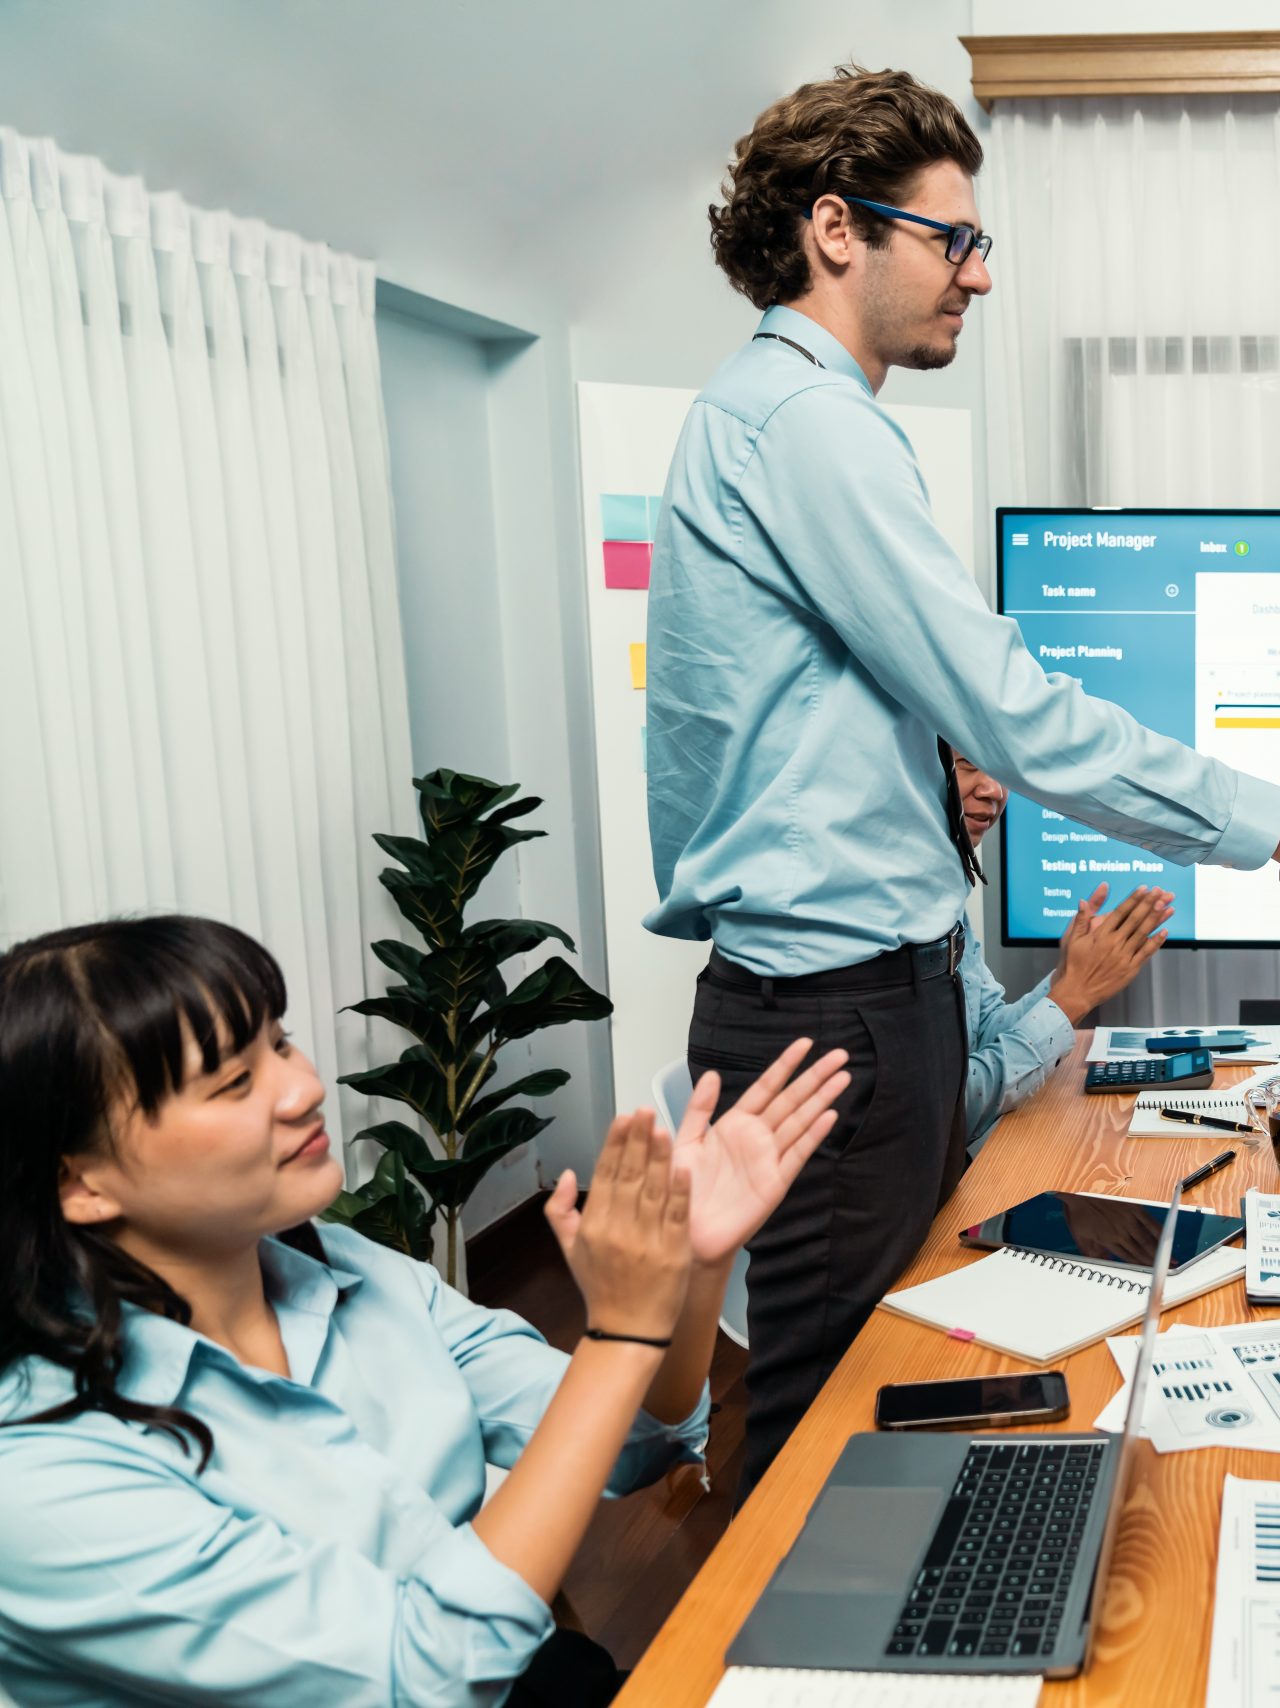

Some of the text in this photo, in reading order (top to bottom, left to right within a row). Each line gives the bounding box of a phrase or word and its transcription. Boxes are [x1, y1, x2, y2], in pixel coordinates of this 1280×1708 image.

[1043, 531, 1158, 552] Project Manager
[1199, 541, 1227, 553] Inbox
[1041, 584, 1097, 598] Task name
[1039, 644, 1123, 661] Project Planning
[1041, 808, 1066, 820] Desig
[1041, 831, 1069, 844] Design
[1041, 858, 1164, 875] Testing & Revision Phase
[1043, 886, 1072, 899] Testing
